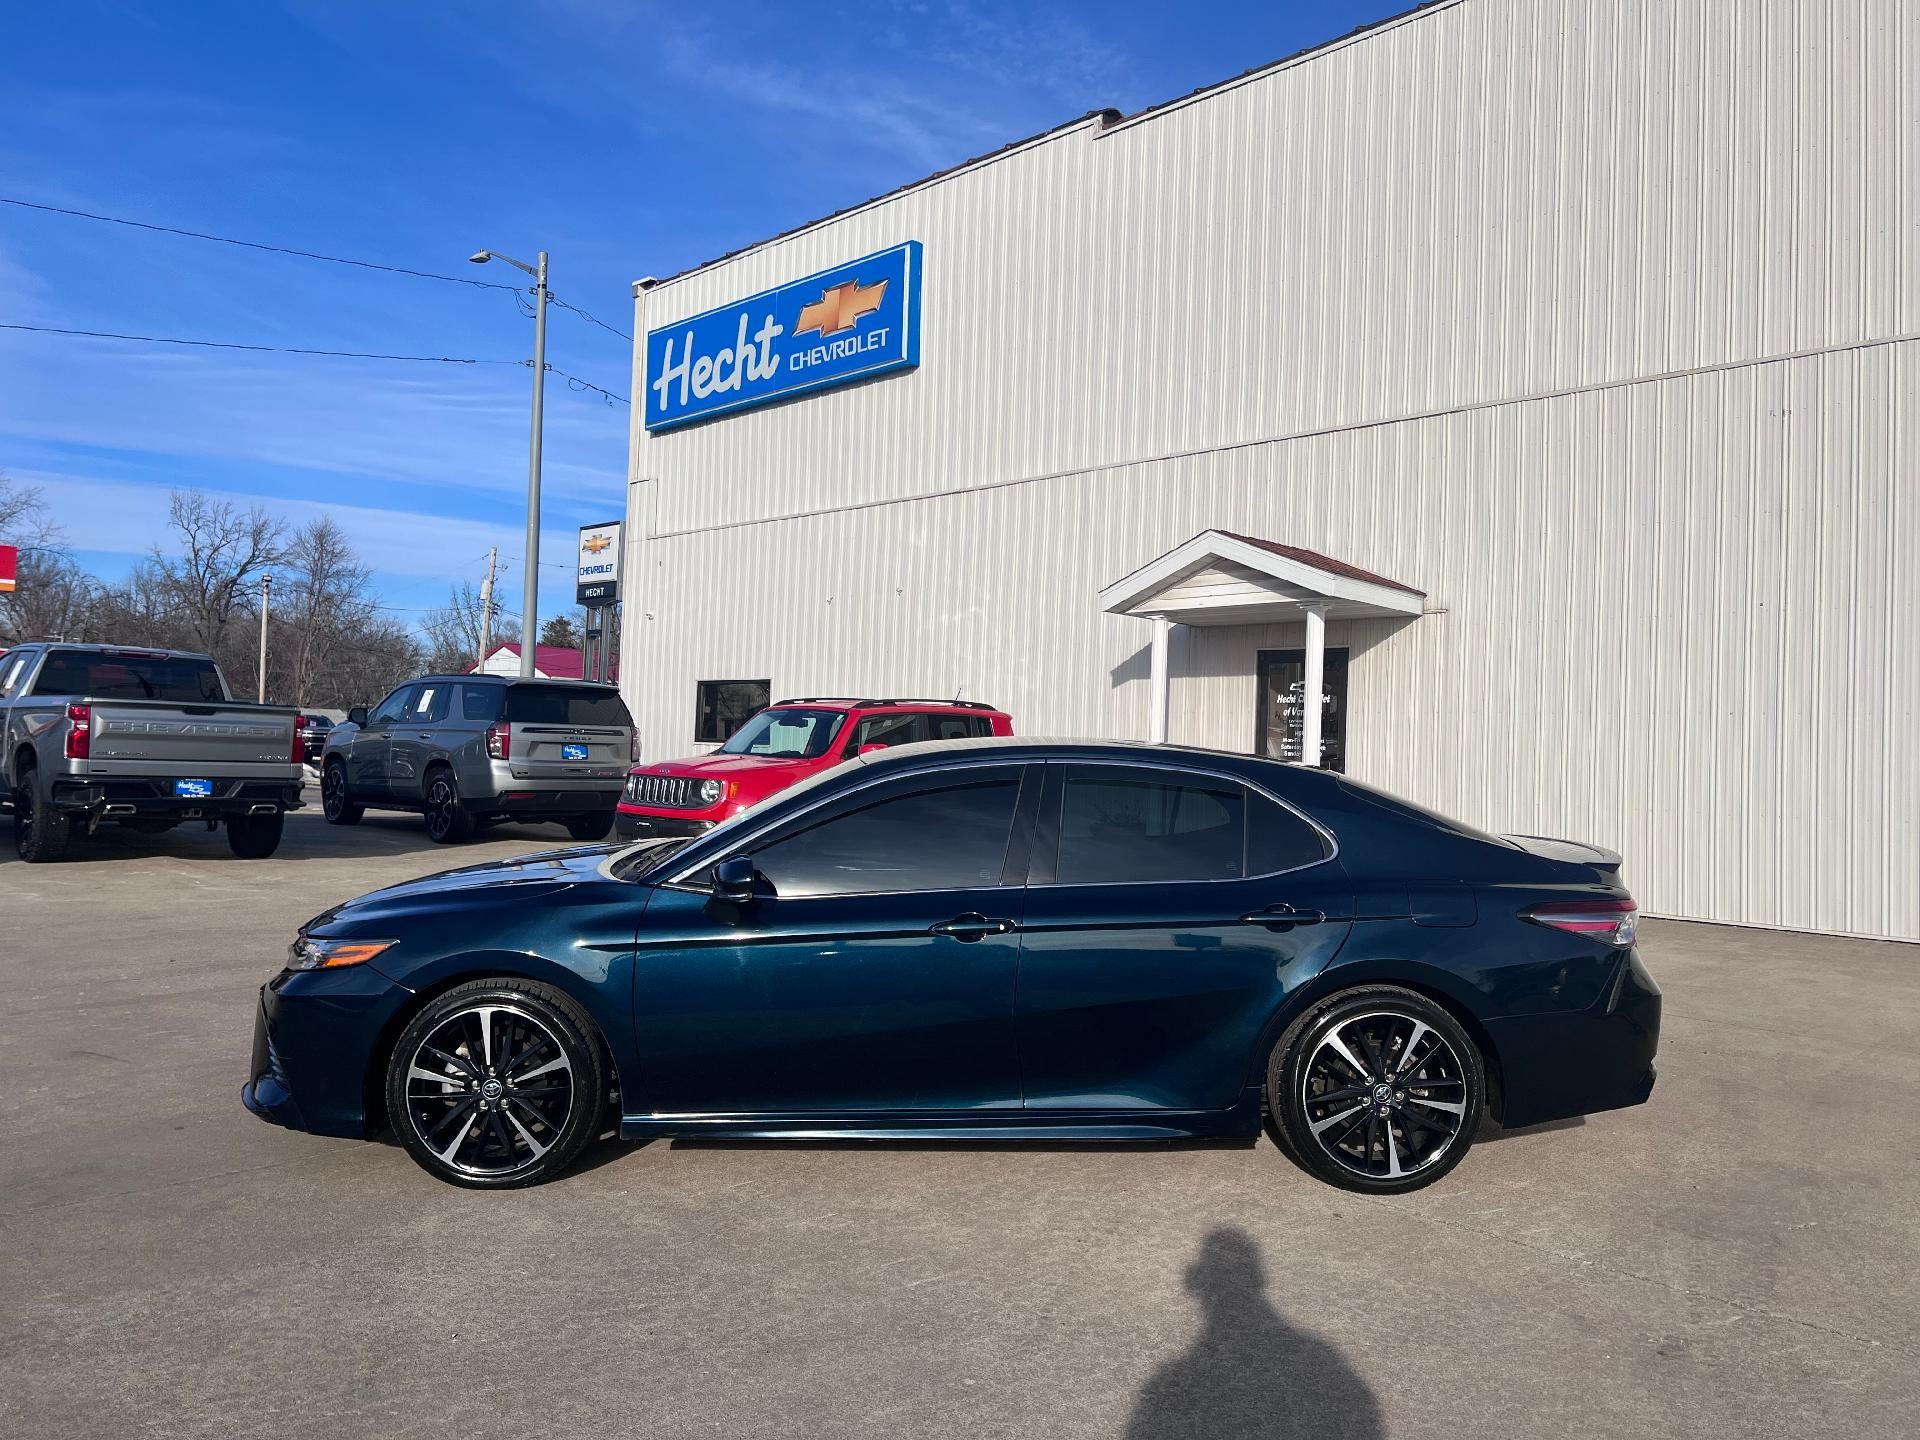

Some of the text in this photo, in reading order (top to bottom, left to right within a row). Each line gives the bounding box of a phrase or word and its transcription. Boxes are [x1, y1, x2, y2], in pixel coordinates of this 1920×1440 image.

[653, 312, 890, 411] Hecht CHEVROLET
[580, 564, 613, 576] CHEVROLET
[585, 587, 604, 598] HECHT
[1276, 694, 1296, 704] Hecht
[108, 721, 284, 737] CHEVROLET
